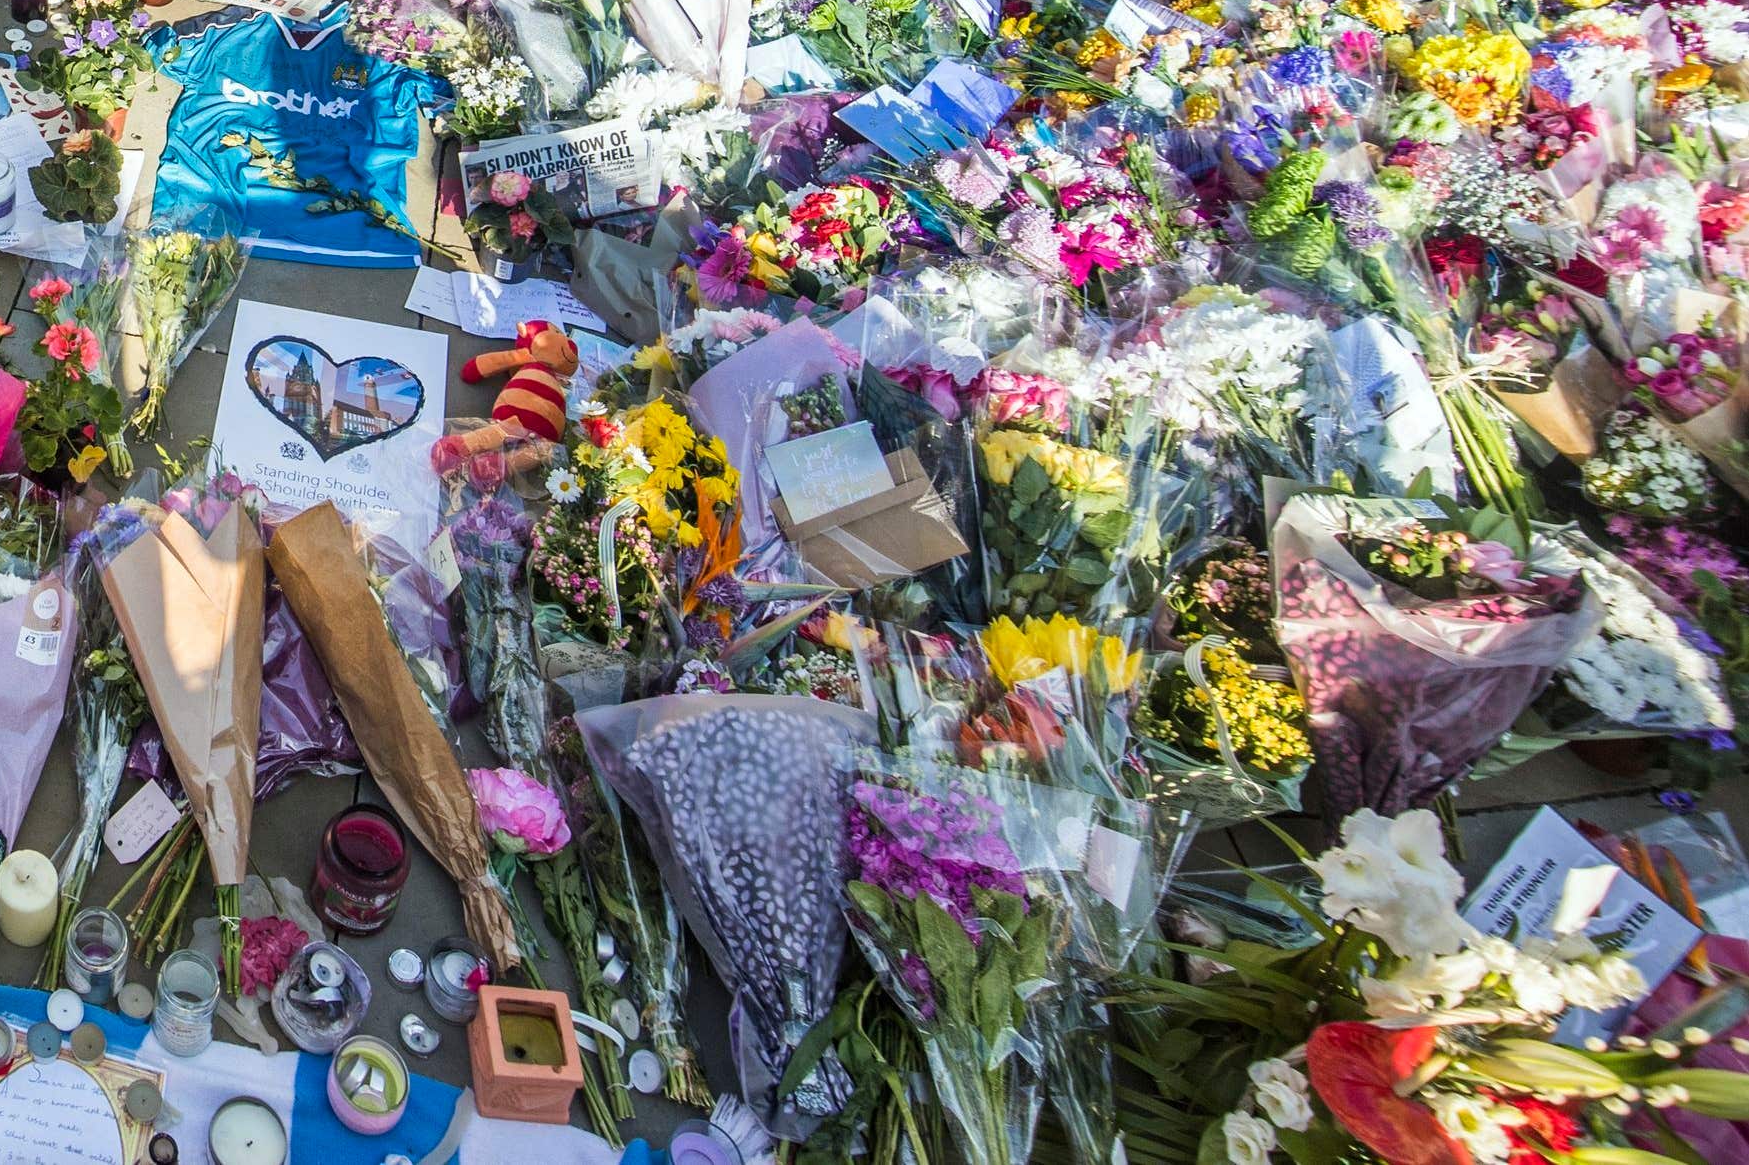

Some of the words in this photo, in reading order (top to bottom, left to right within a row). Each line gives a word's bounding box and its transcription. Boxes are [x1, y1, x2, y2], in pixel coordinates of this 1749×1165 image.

[221, 77, 360, 121] brother
[505, 145, 553, 169] DIDN'T
[557, 135, 606, 159] KNOW
[610, 130, 629, 147] OF
[522, 154, 596, 180] MARRIAGE
[600, 145, 635, 163] HELL
[254, 462, 322, 486] Standing
[323, 475, 393, 502] Shoulder
[264, 479, 332, 502] Shoulder
[335, 495, 369, 513] with
[24, 634, 37, 645] £3
[1510, 857, 1559, 910] STRONGER
